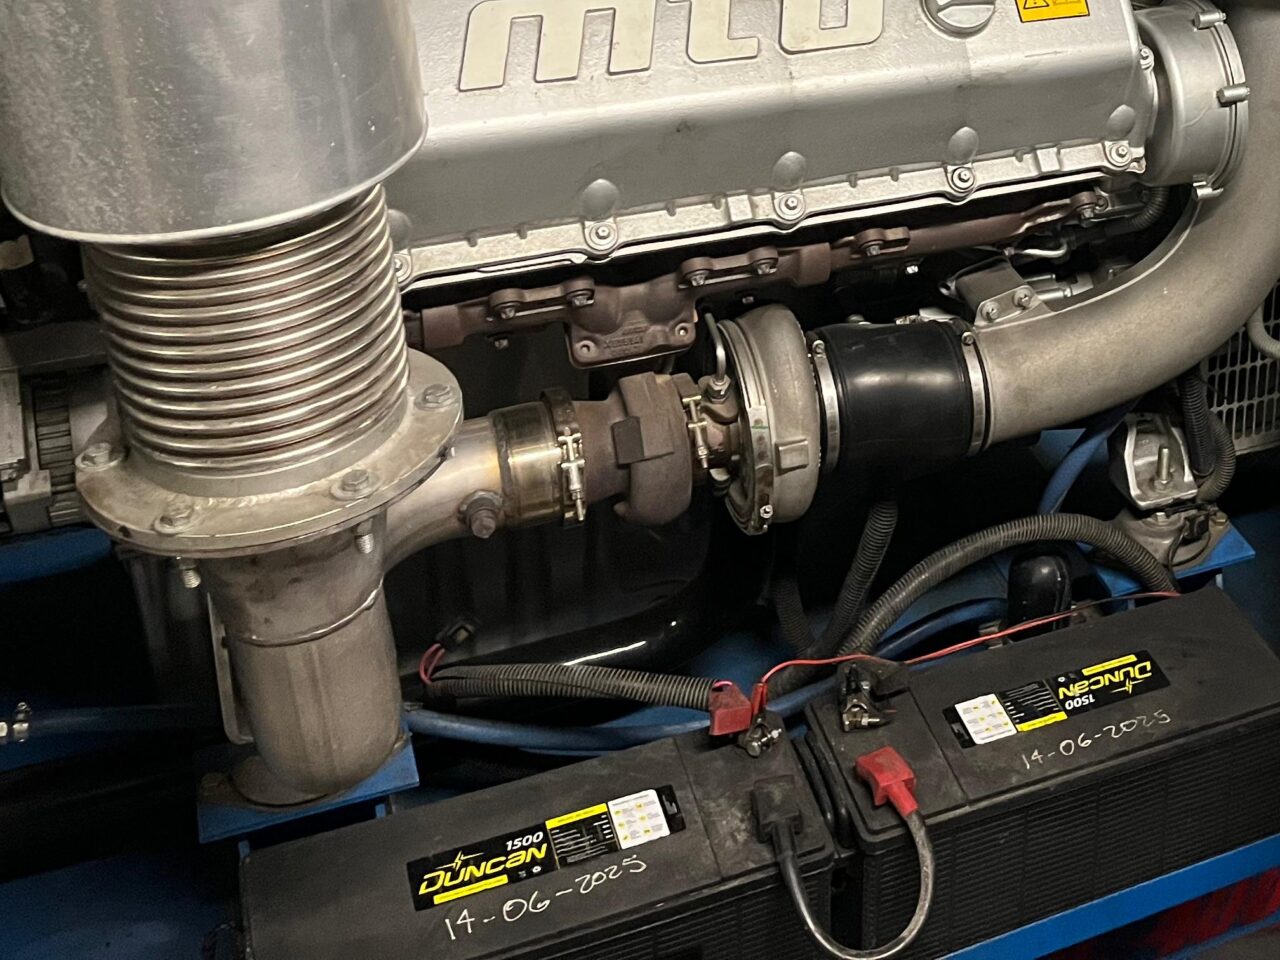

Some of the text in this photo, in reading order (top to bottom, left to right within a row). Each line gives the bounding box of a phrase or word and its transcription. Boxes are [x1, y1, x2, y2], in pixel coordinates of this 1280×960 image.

[1064, 693, 1096, 711] 1500
[1019, 708, 1172, 770] 14-06-2025
[505, 831, 544, 852] 1500
[444, 854, 647, 941] 14-06-2025
